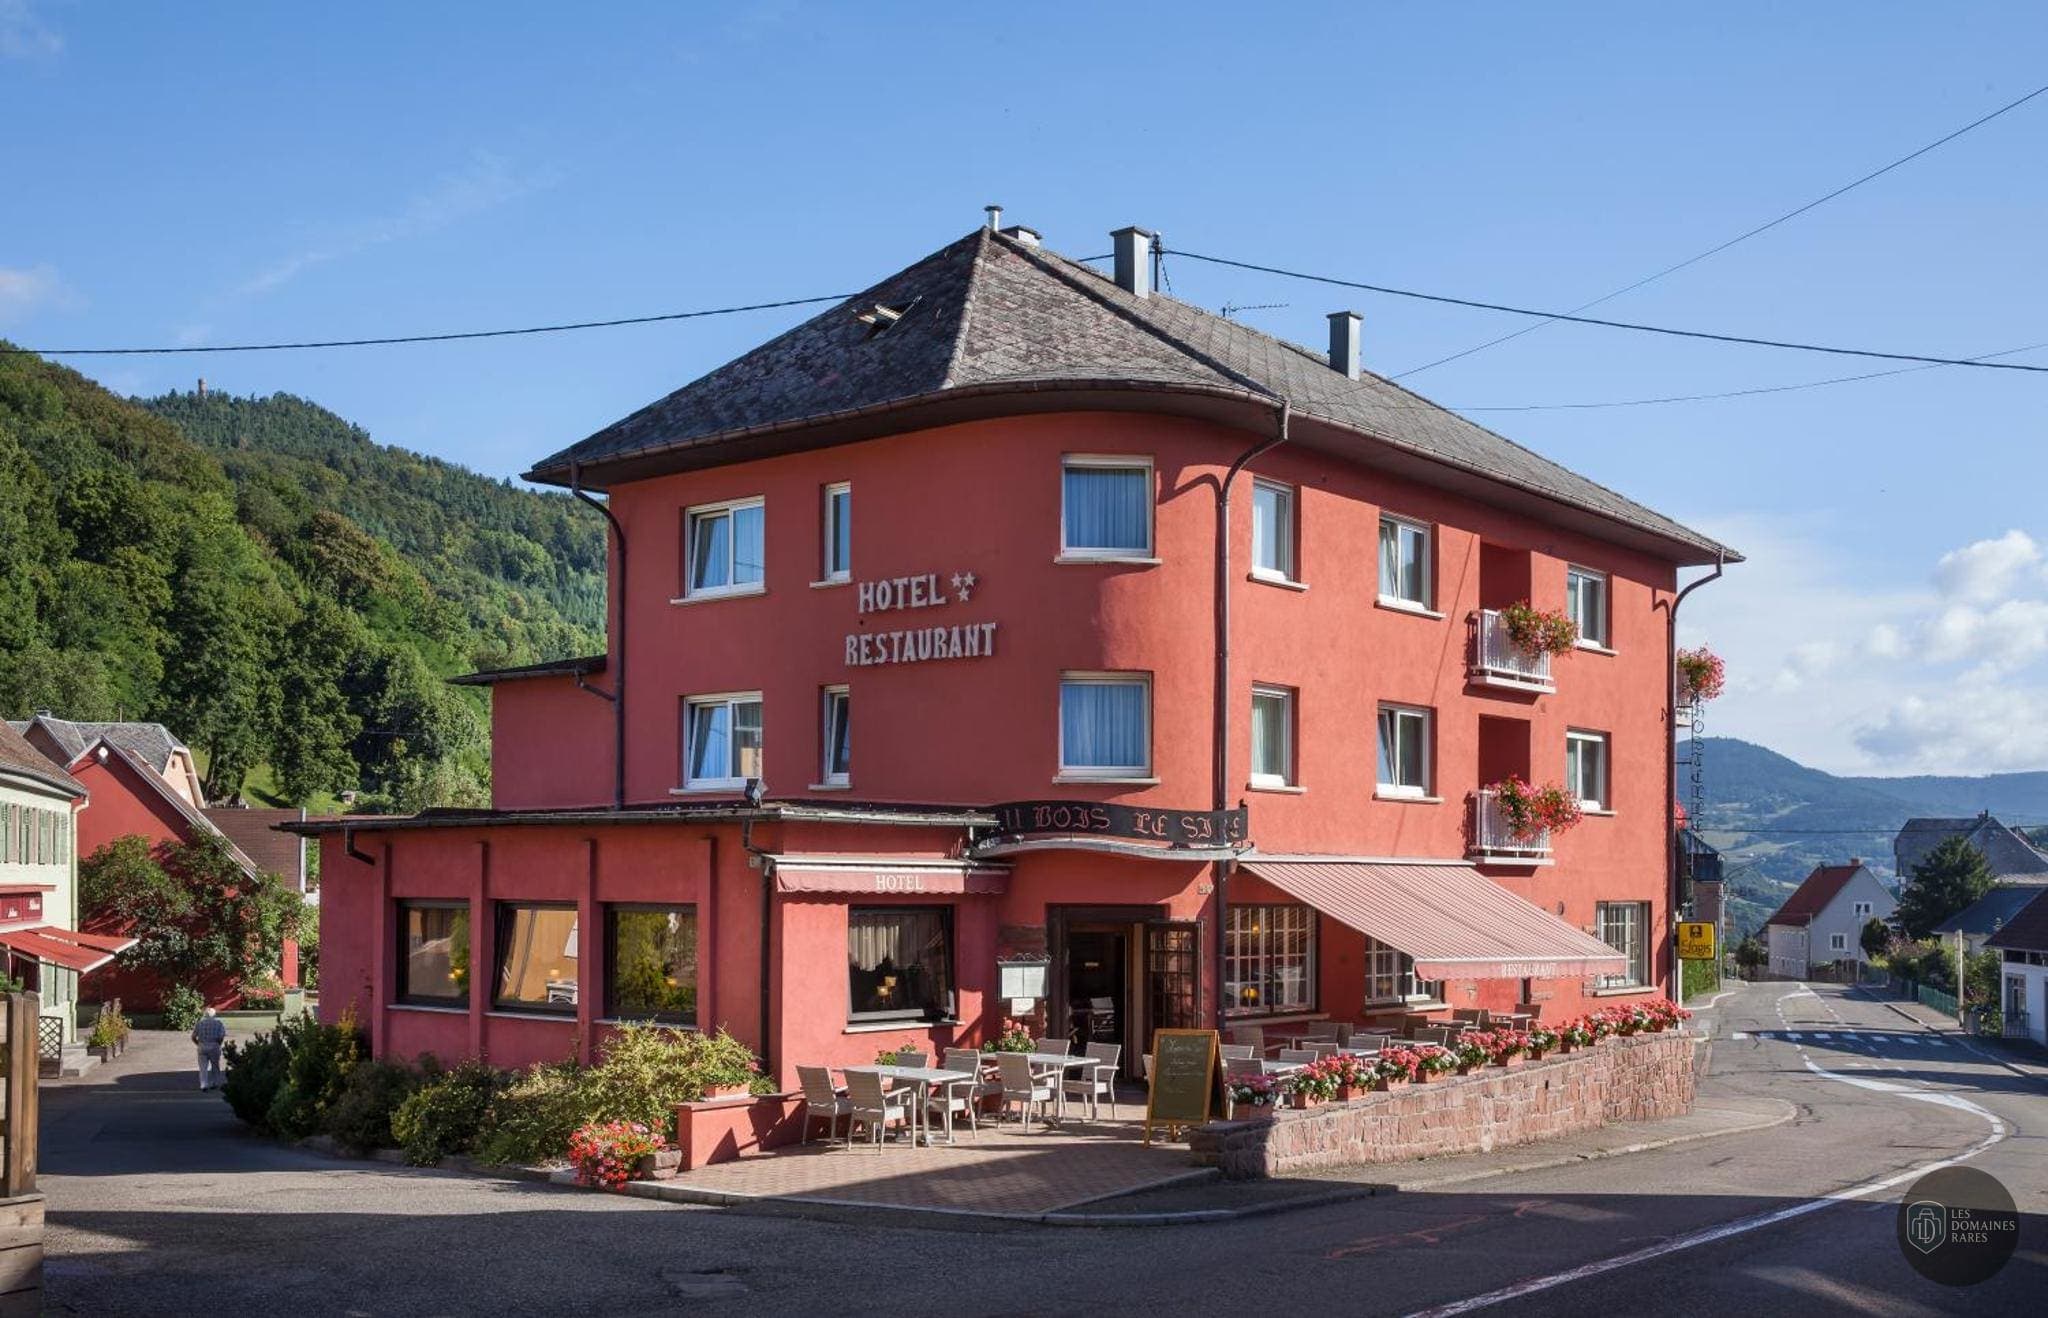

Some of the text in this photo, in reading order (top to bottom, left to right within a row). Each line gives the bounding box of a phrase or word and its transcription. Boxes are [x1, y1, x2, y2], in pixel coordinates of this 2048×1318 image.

[858, 574, 946, 613] HOTEL
[845, 622, 996, 667] RESTAURANT
[1033, 805, 1110, 829] BOIS
[1133, 812, 1168, 837] LE
[875, 874, 924, 892] HOTEL
